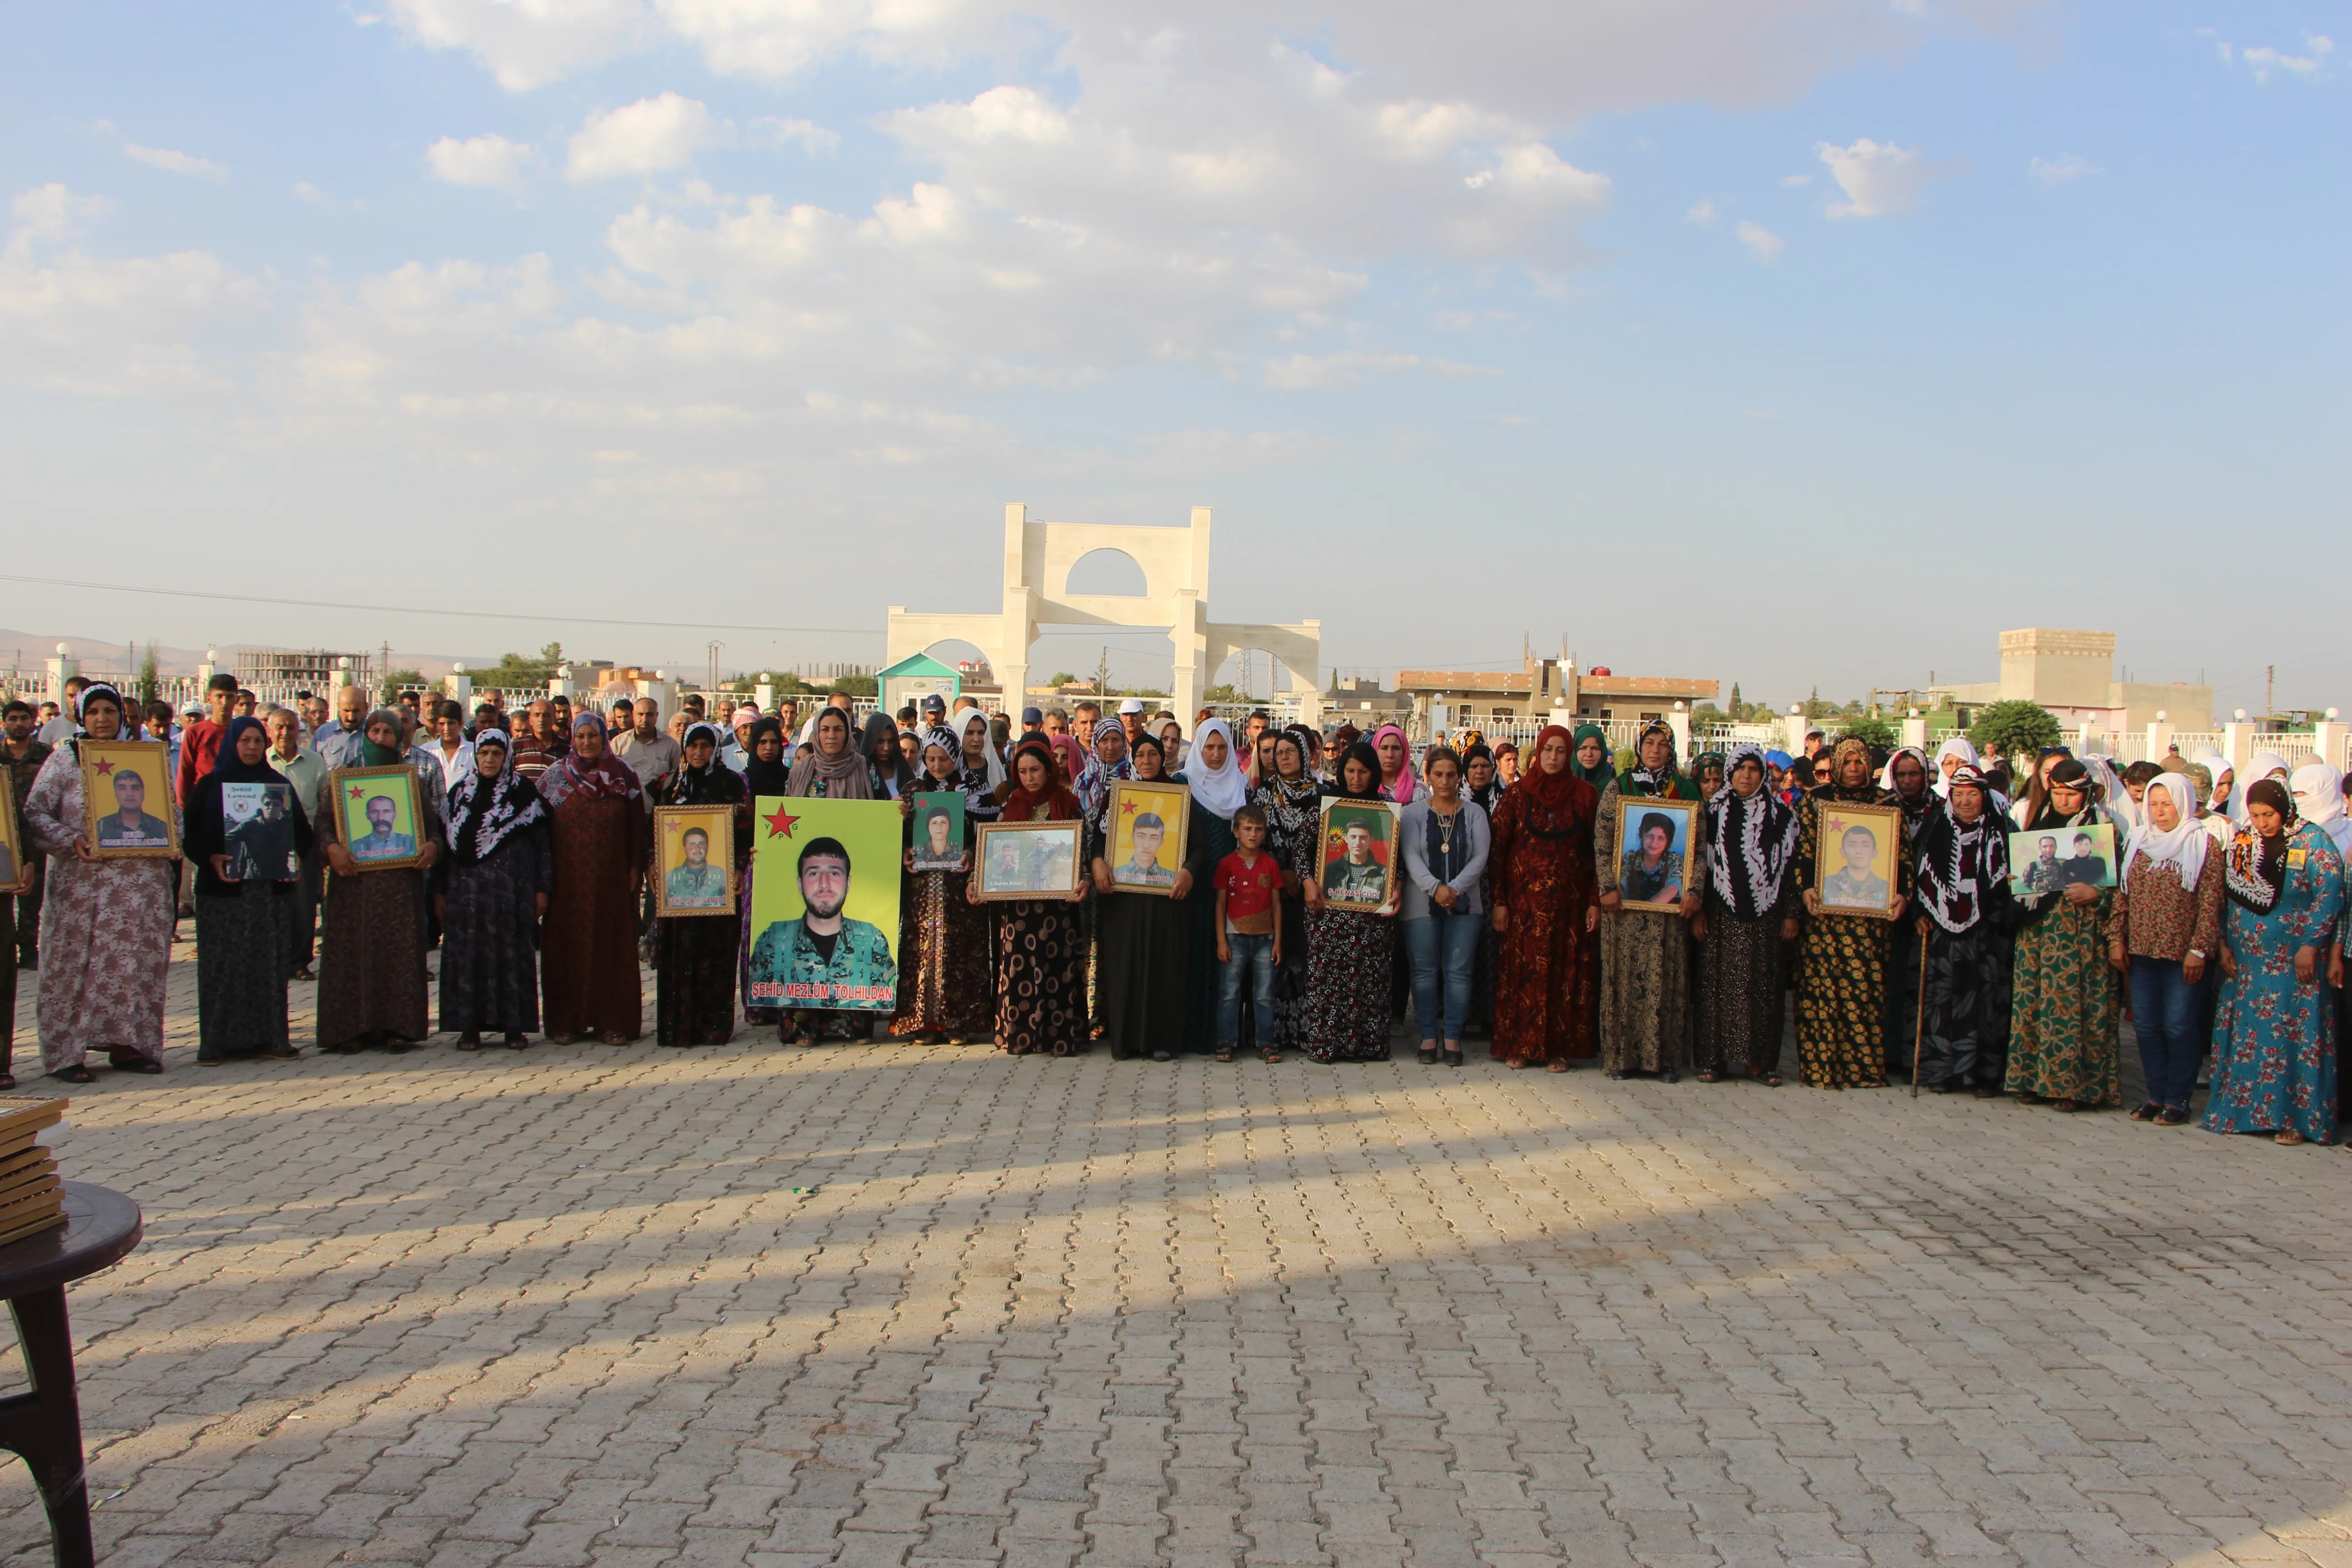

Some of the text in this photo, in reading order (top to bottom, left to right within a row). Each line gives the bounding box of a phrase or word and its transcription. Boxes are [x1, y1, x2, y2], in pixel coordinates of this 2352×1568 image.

[752, 980, 893, 1001] ŞEHÎD MEZLÛM TOLHILDAN
